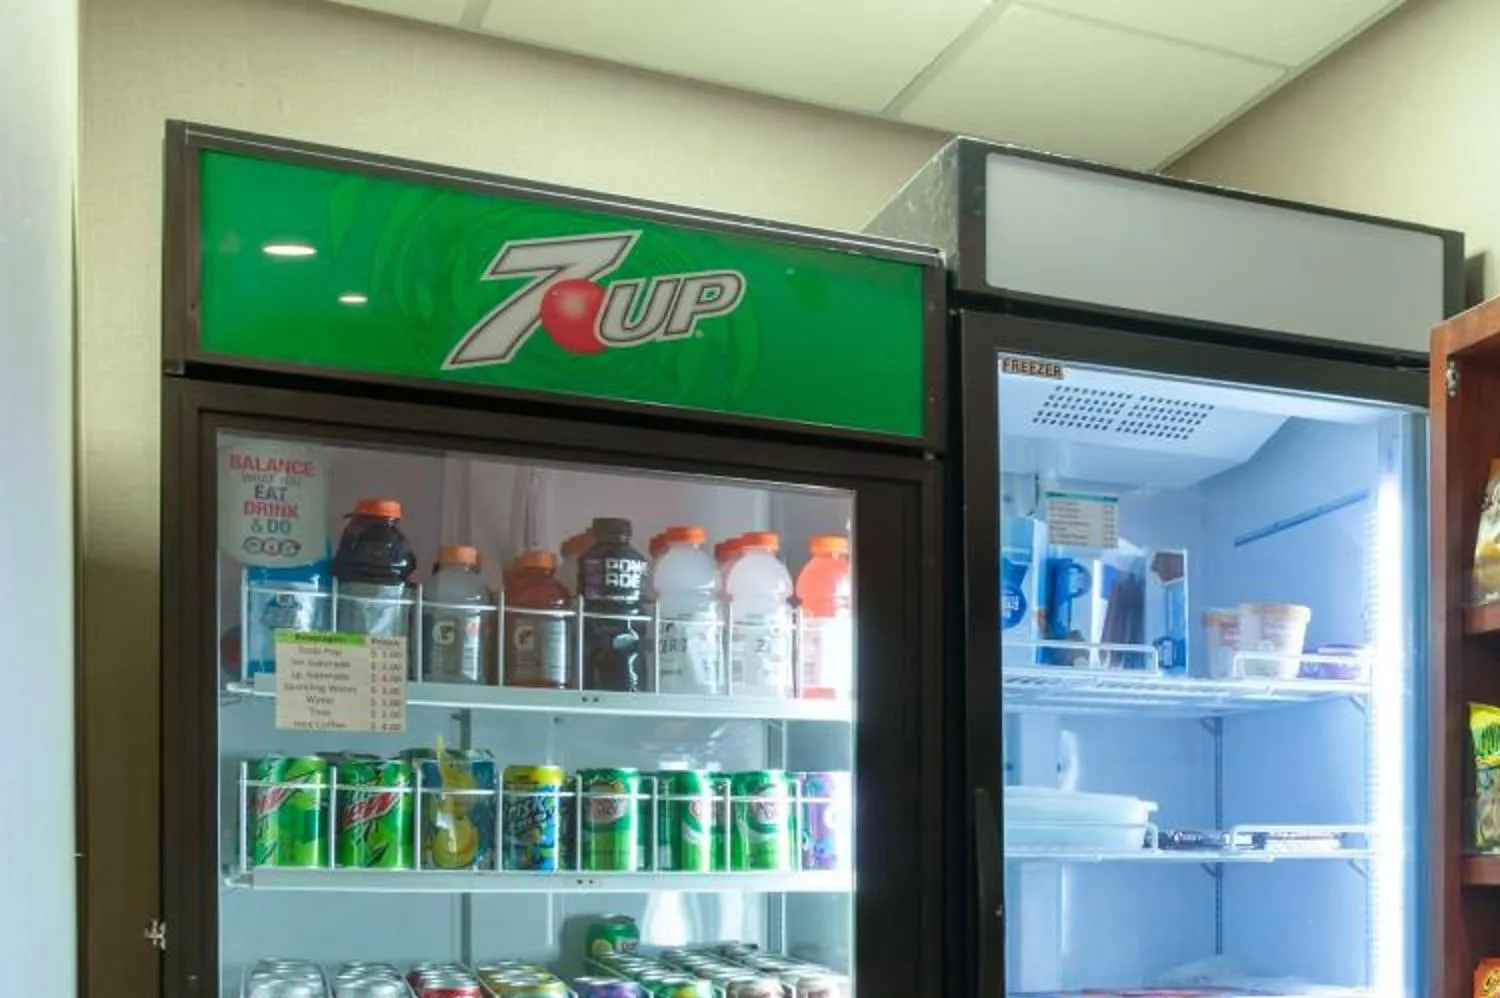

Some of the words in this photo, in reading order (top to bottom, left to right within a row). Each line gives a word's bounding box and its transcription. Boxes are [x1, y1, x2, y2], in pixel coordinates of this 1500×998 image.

[1001, 357, 1061, 379] FREEZER
[228, 453, 316, 477] BALANCE
[254, 484, 288, 501] EAT
[244, 500, 299, 519] DRINK
[266, 519, 292, 534] DO
